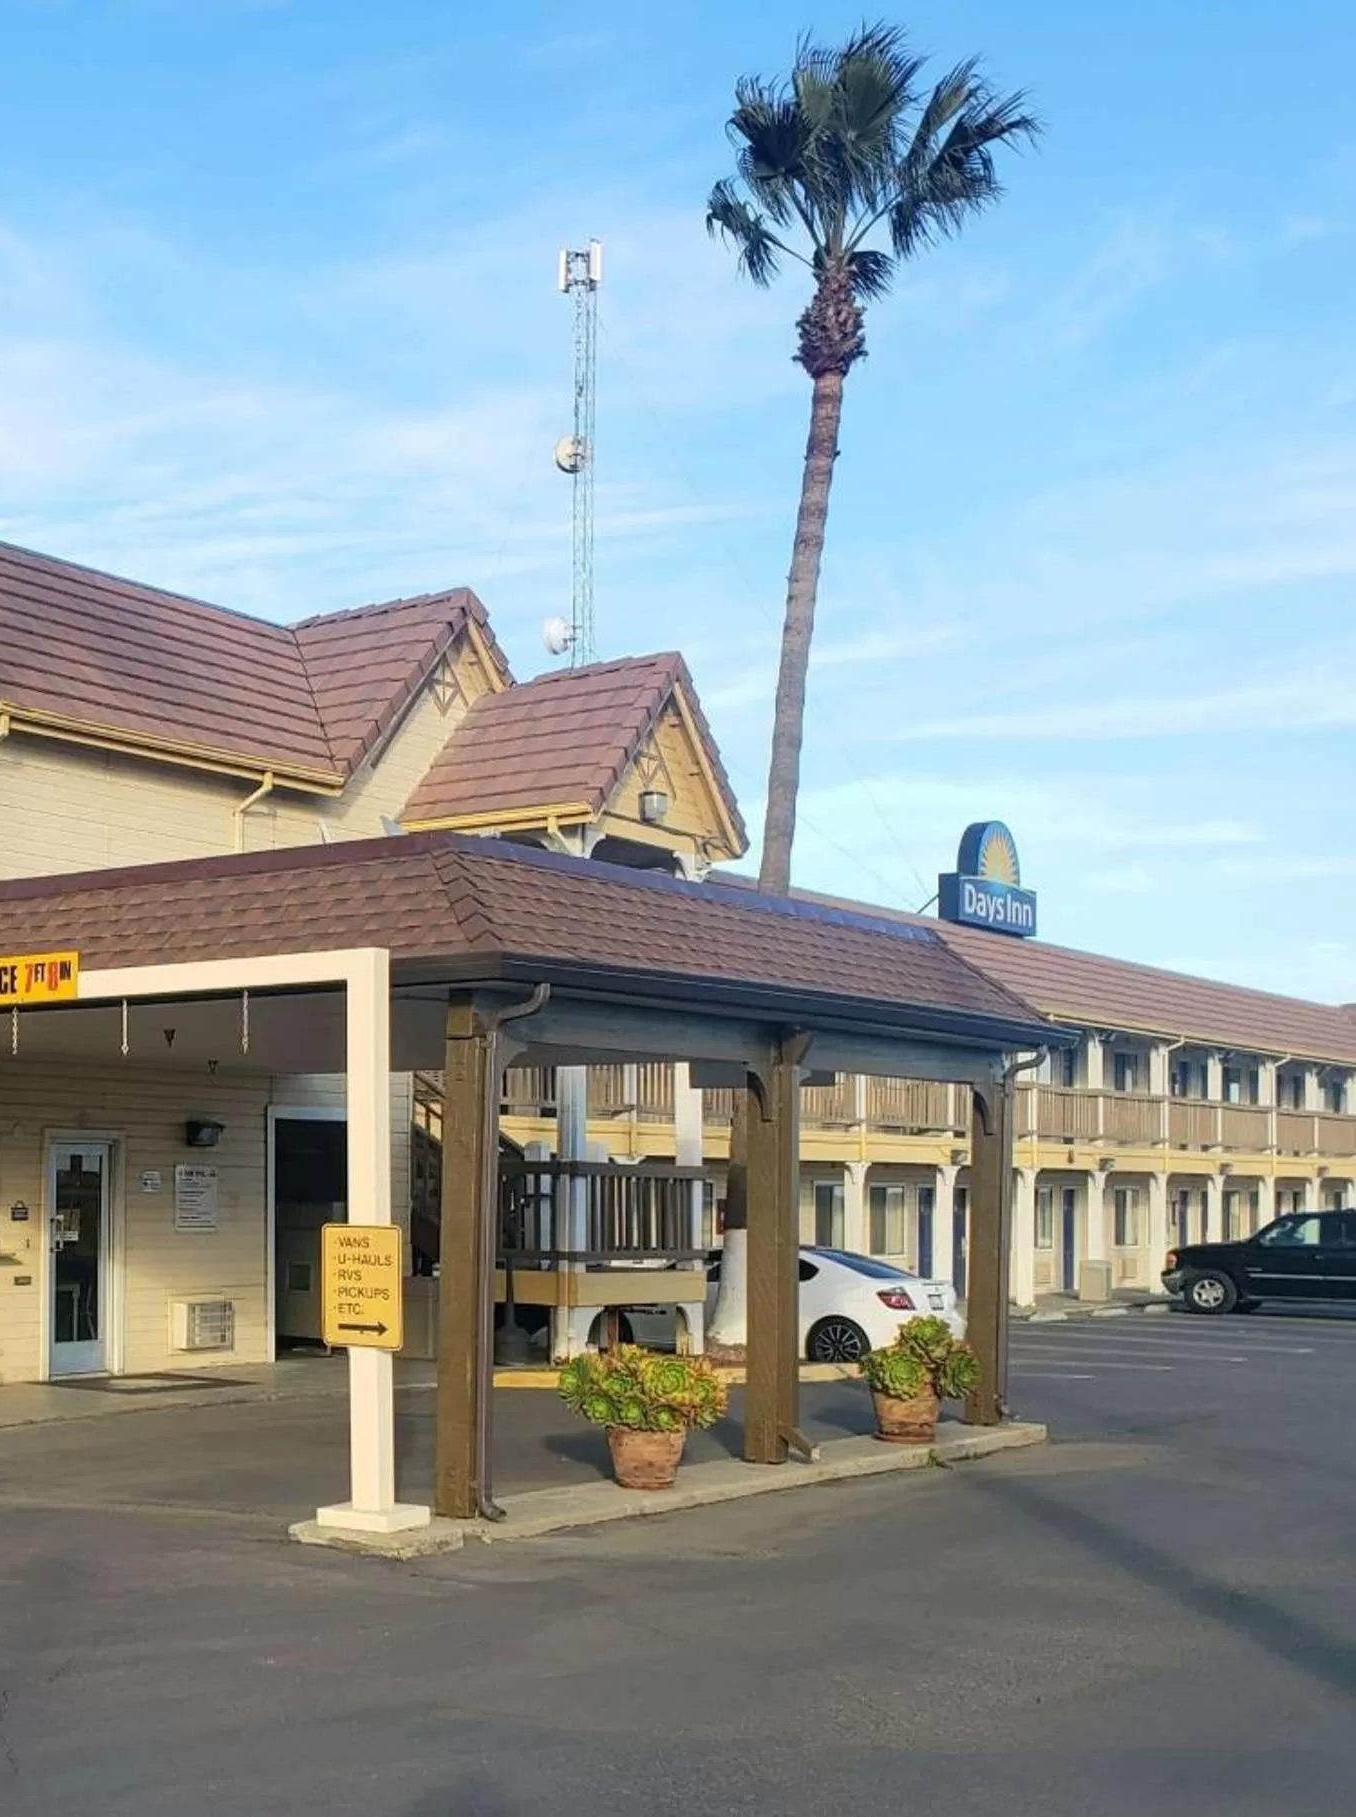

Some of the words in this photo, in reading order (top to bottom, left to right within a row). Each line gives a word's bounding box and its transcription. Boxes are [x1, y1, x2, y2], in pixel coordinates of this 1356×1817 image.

[964, 883, 1004, 923] Days
[1007, 893, 1032, 928] Inn
[338, 1236, 370, 1248] VANS
[337, 1254, 393, 1266] U-HAULS
[337, 1269, 362, 1281] RVS
[337, 1287, 390, 1300] PICKUPS
